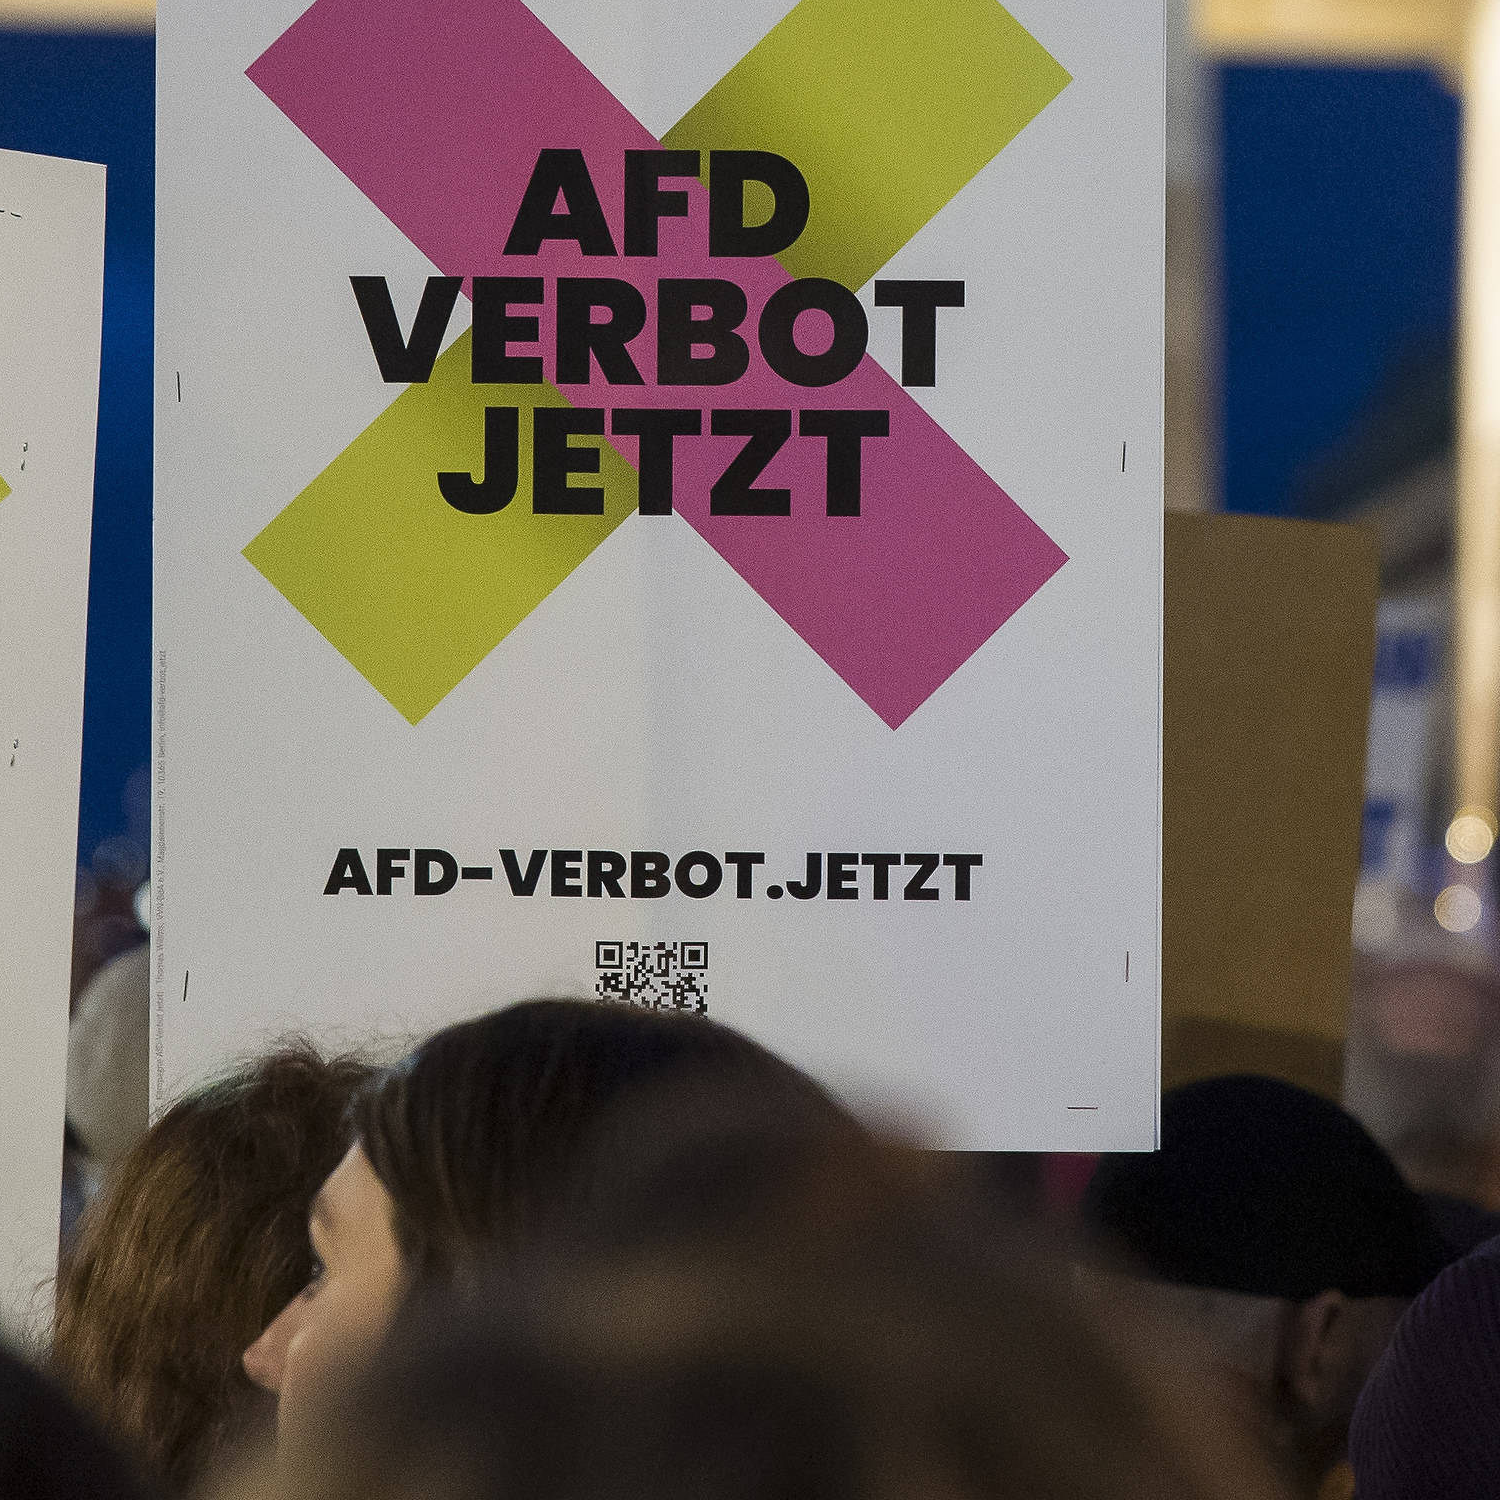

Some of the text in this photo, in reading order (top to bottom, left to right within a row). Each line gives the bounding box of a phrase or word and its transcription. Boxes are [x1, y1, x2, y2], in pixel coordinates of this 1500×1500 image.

[502, 148, 811, 258] AFD
[348, 275, 965, 388] VERBOT
[436, 406, 890, 517] JETZT
[322, 848, 983, 901] AFD-VERBOT.JETZT
